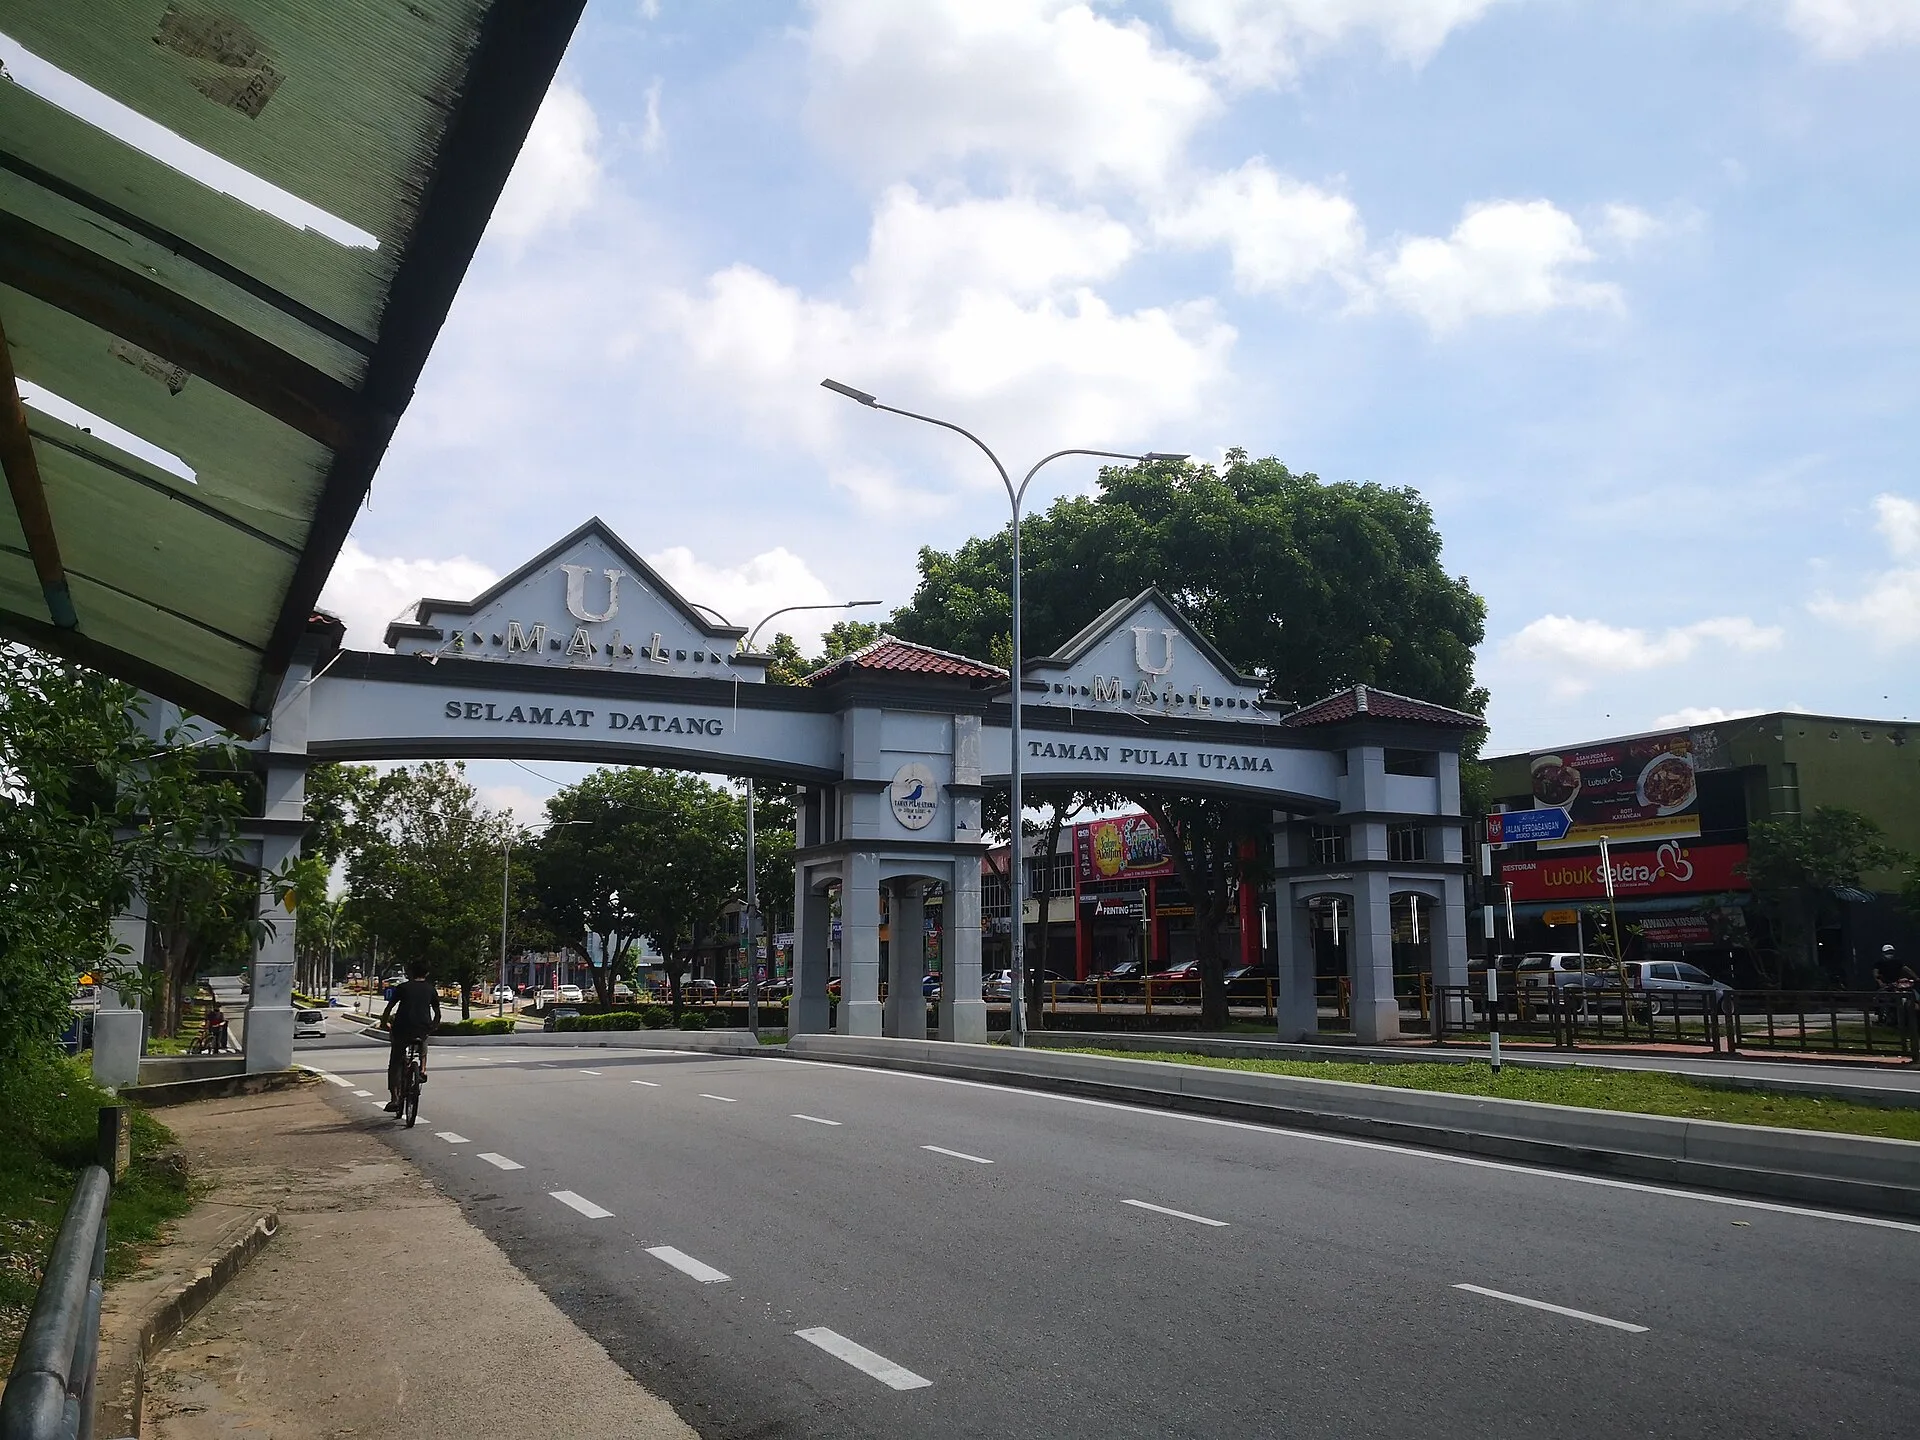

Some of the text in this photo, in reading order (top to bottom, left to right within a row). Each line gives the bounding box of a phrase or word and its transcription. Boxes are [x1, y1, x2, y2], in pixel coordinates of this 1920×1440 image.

[561, 564, 626, 623] U
[508, 620, 670, 665] MALL
[1131, 627, 1179, 675] U
[1094, 675, 1212, 713] MALL
[445, 700, 724, 736] SELAMAT DATANG
[1028, 742, 1274, 772] TAMAN PULAI UTAMA
[1505, 824, 1521, 834] JALAN
[1522, 821, 1560, 833] PERDAGANGAN
[1502, 863, 1537, 872] RESTORAN
[1544, 865, 1594, 887] Lubuk
[1103, 906, 1129, 915] PRINTING
